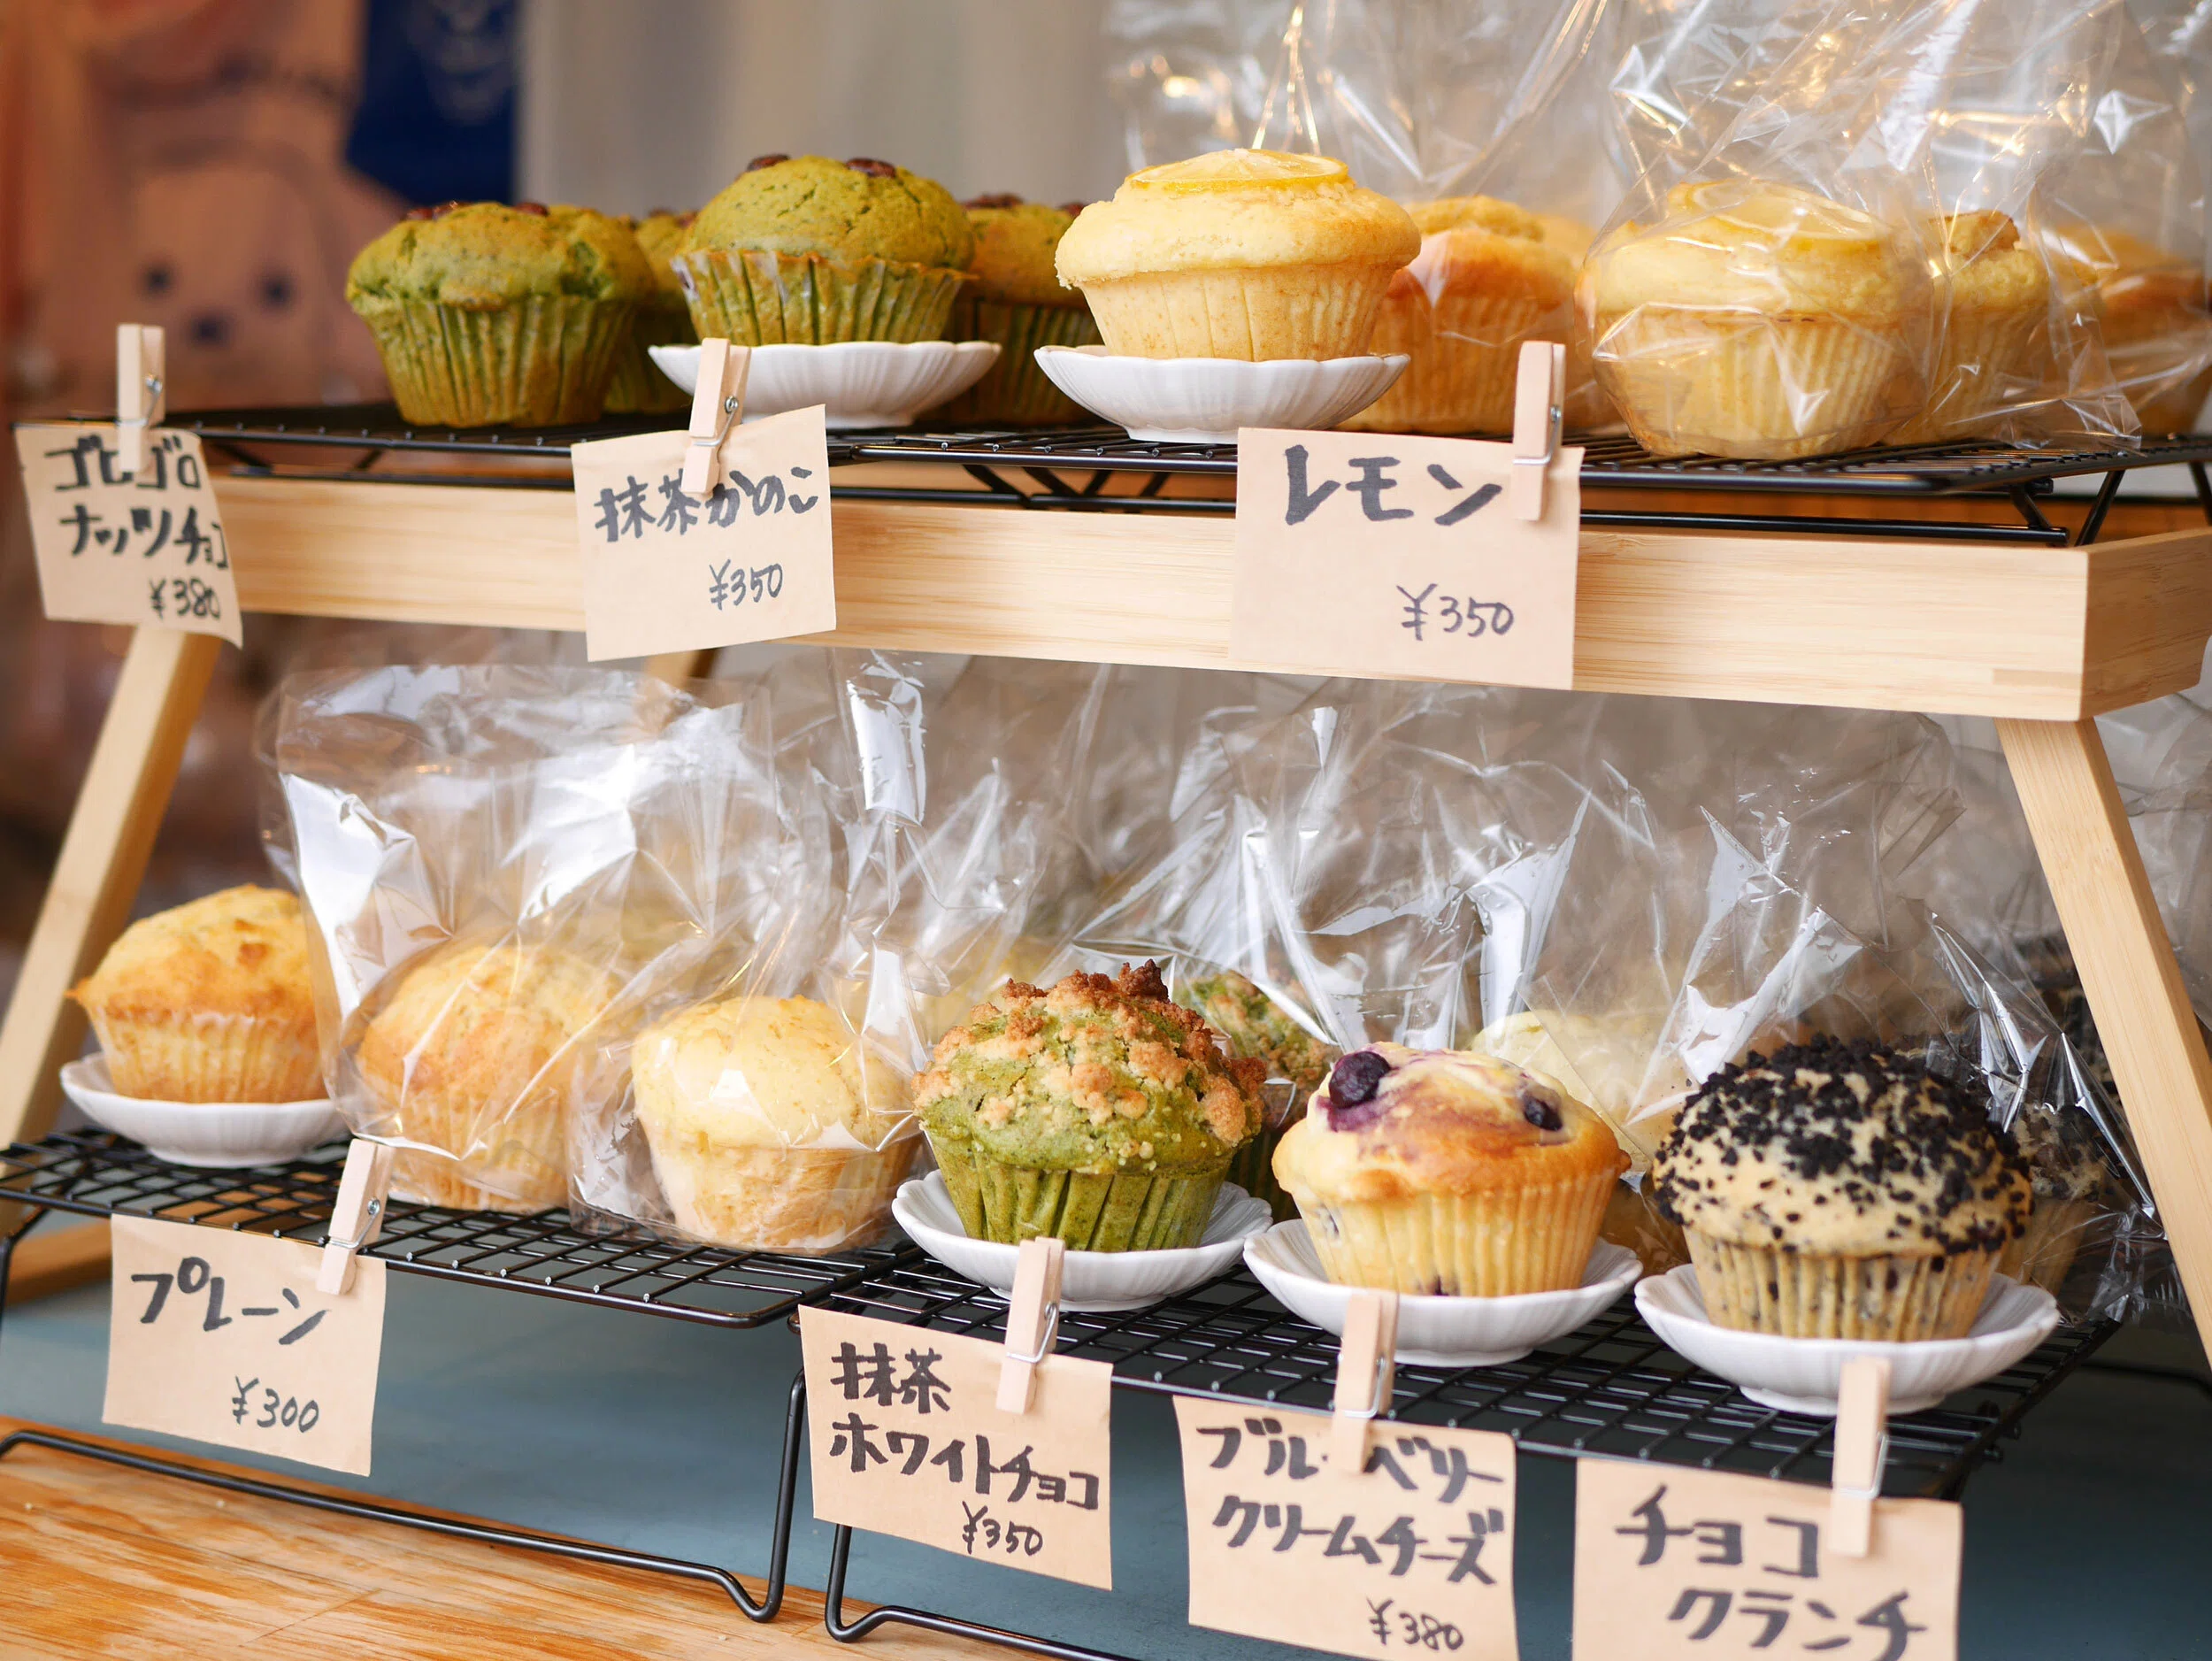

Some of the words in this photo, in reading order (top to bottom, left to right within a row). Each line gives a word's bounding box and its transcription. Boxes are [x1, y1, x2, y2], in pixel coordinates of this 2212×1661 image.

[1284, 444, 1502, 526] レモン
[150, 577, 220, 619] ¥380
[709, 559, 783, 610] ¥350
[1396, 583, 1514, 641] ¥350
[131, 1257, 331, 1345] プレーン
[232, 1376, 319, 1433] ¥300
[830, 1342, 951, 1414] 抹茶
[829, 1412, 1099, 1510] ホワイトチョコ
[1196, 1418, 1504, 1503] ブルベリー
[962, 1501, 1043, 1556] ¥350
[1212, 1495, 1504, 1585] クリームチーズ
[1615, 1483, 1819, 1579] チョコ
[1366, 1596, 1464, 1651] ¥380
[1667, 1587, 1928, 1661] クランチ
